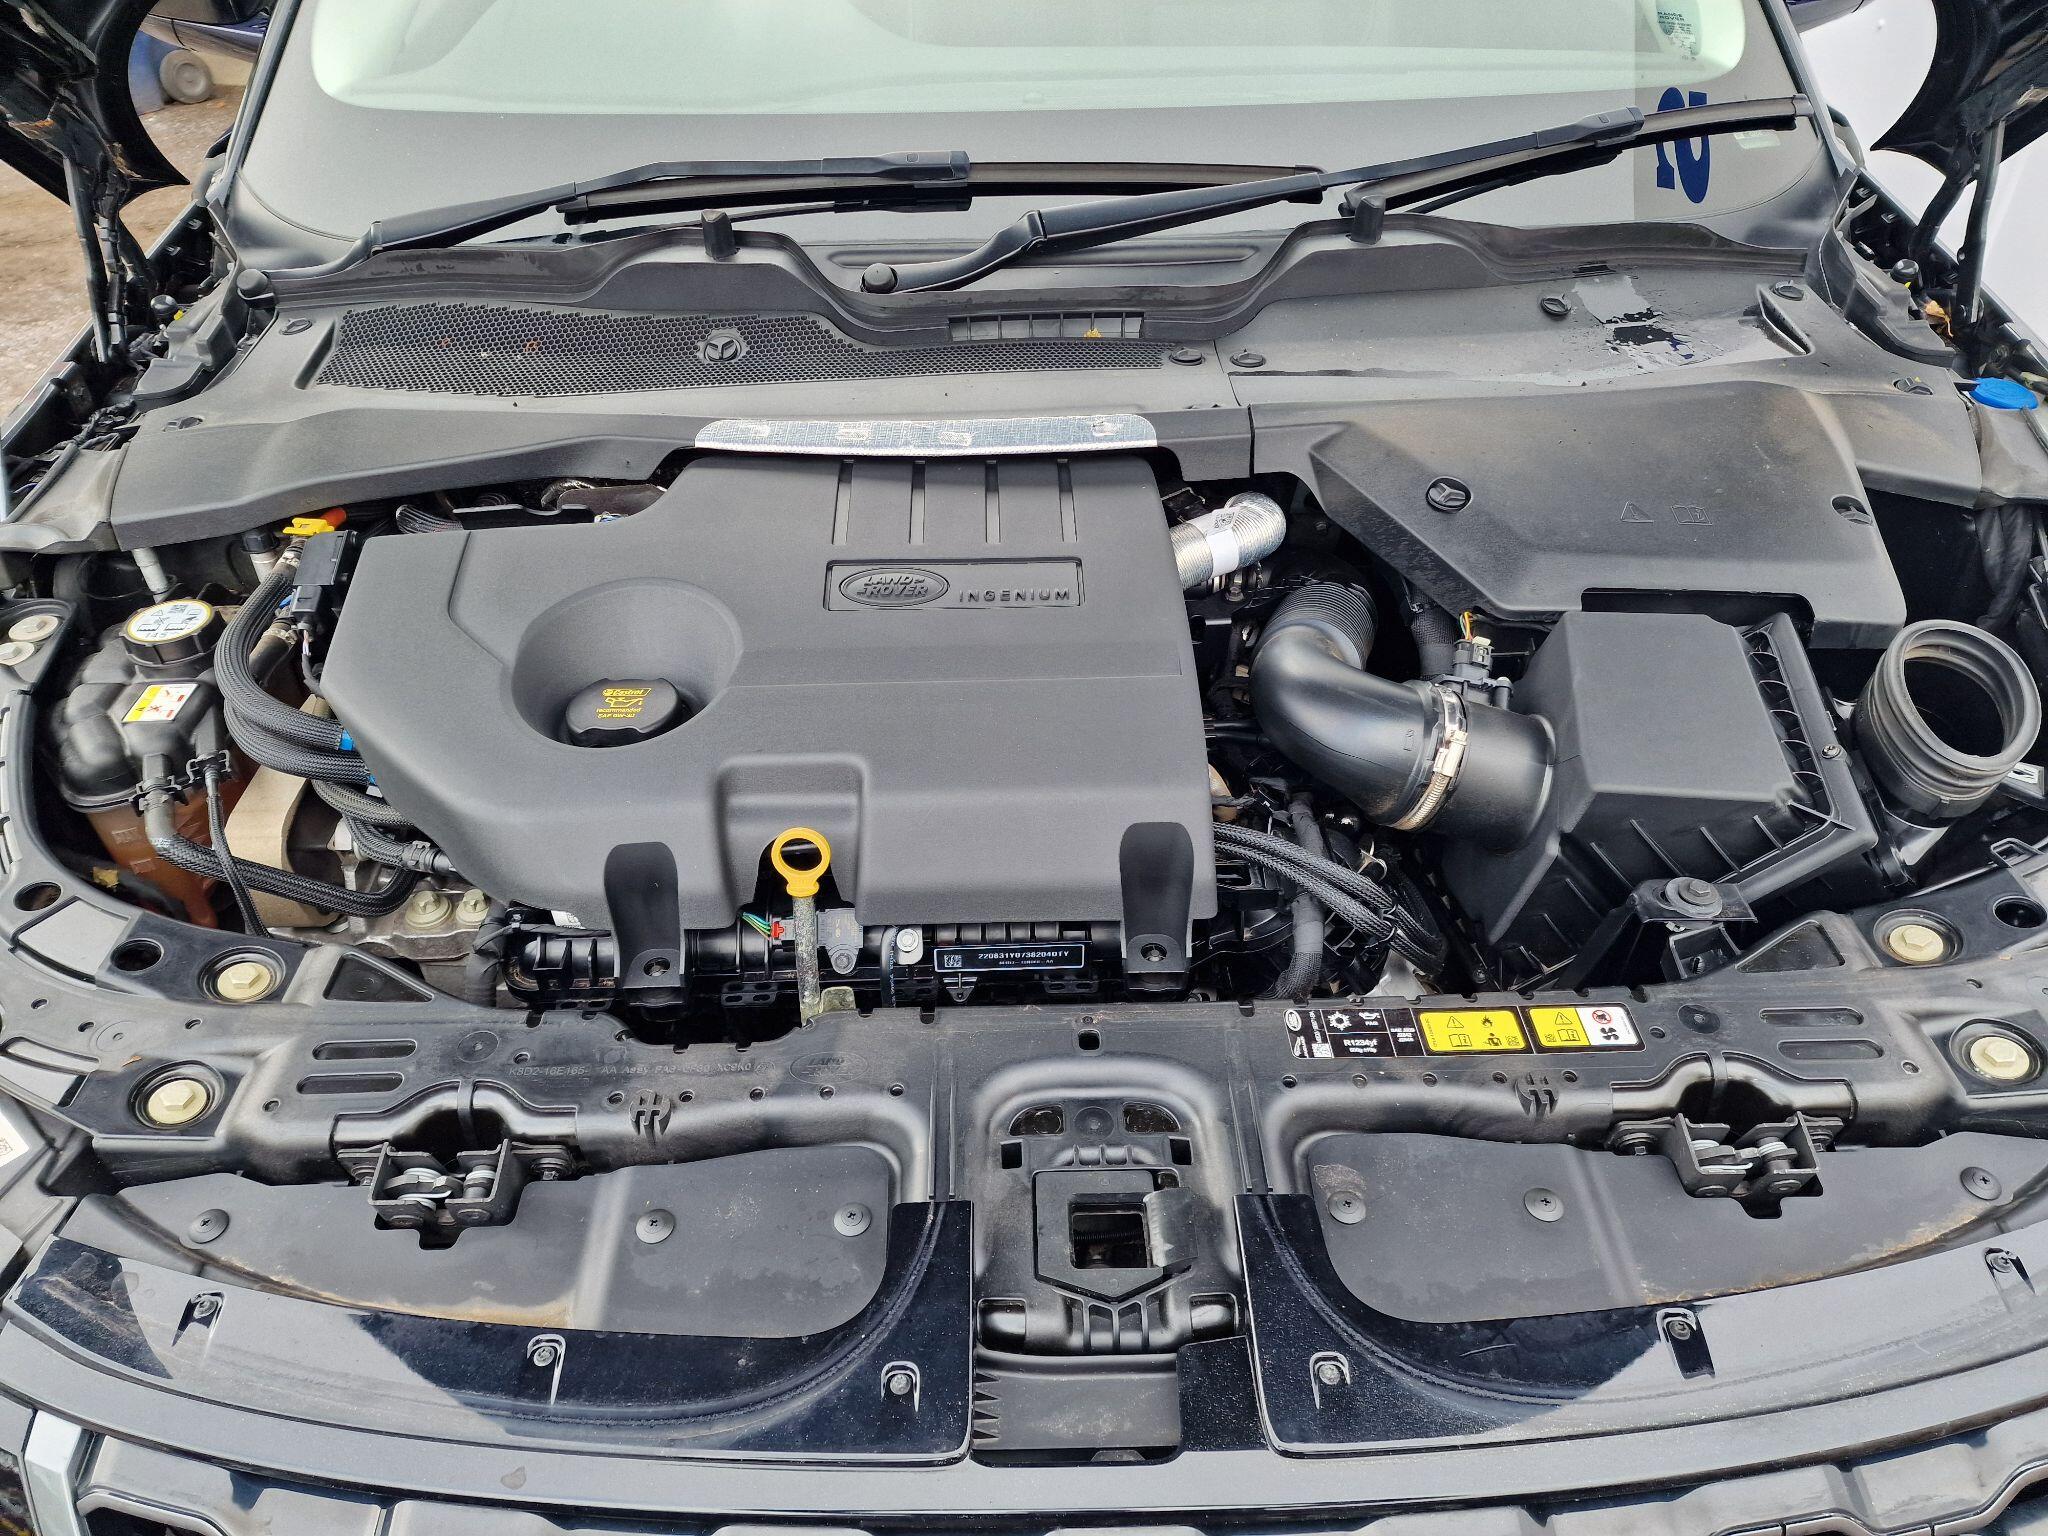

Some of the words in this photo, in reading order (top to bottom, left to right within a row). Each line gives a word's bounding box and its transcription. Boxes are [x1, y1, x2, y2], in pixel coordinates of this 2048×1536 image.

[864, 575, 914, 587] LAND
[862, 585, 929, 599] ROVER
[959, 587, 1070, 603] INGENIUM
